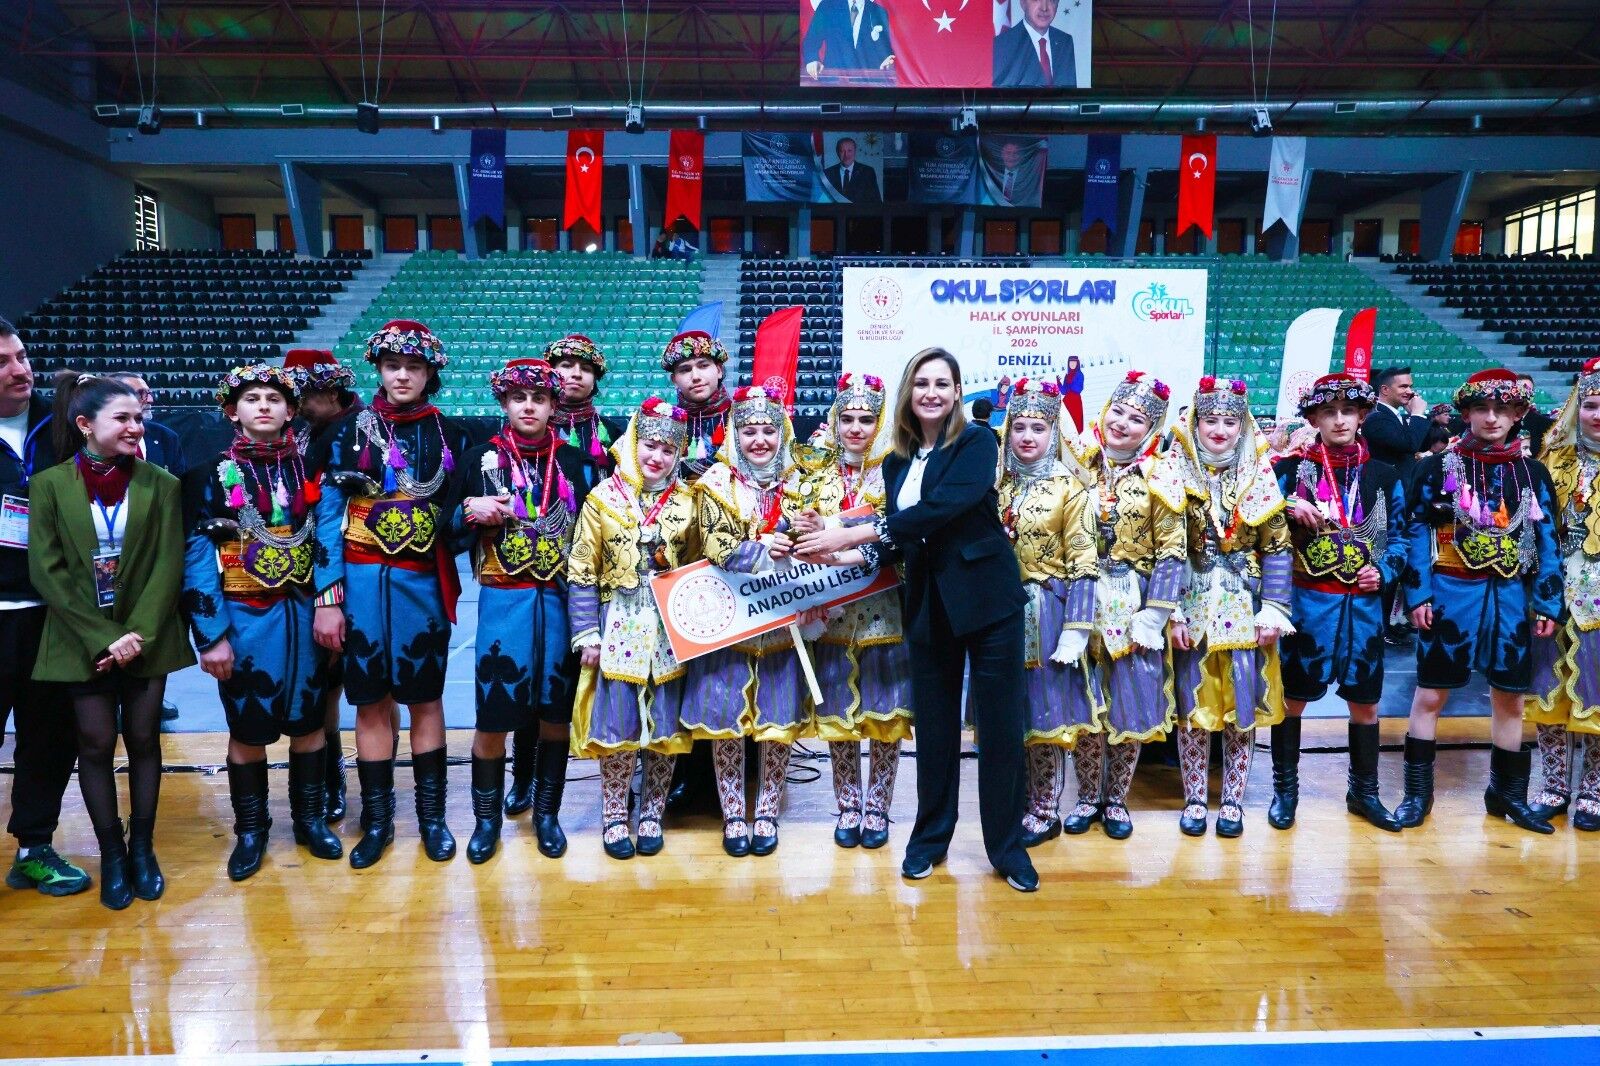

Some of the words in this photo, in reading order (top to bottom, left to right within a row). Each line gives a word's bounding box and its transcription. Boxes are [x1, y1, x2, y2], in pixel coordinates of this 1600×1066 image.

[930, 279, 997, 303] OKUL
[999, 279, 1117, 304] SPORLARI
[969, 311, 1006, 322] HALK
[1011, 311, 1081, 322] OYUNLARI
[992, 324, 1002, 335] İL
[1006, 324, 1084, 337] ŞAMPİYONASI
[1010, 338, 1038, 348] 2026
[998, 352, 1052, 366] DENİZLİ
[747, 578, 825, 617] ANADOLU
